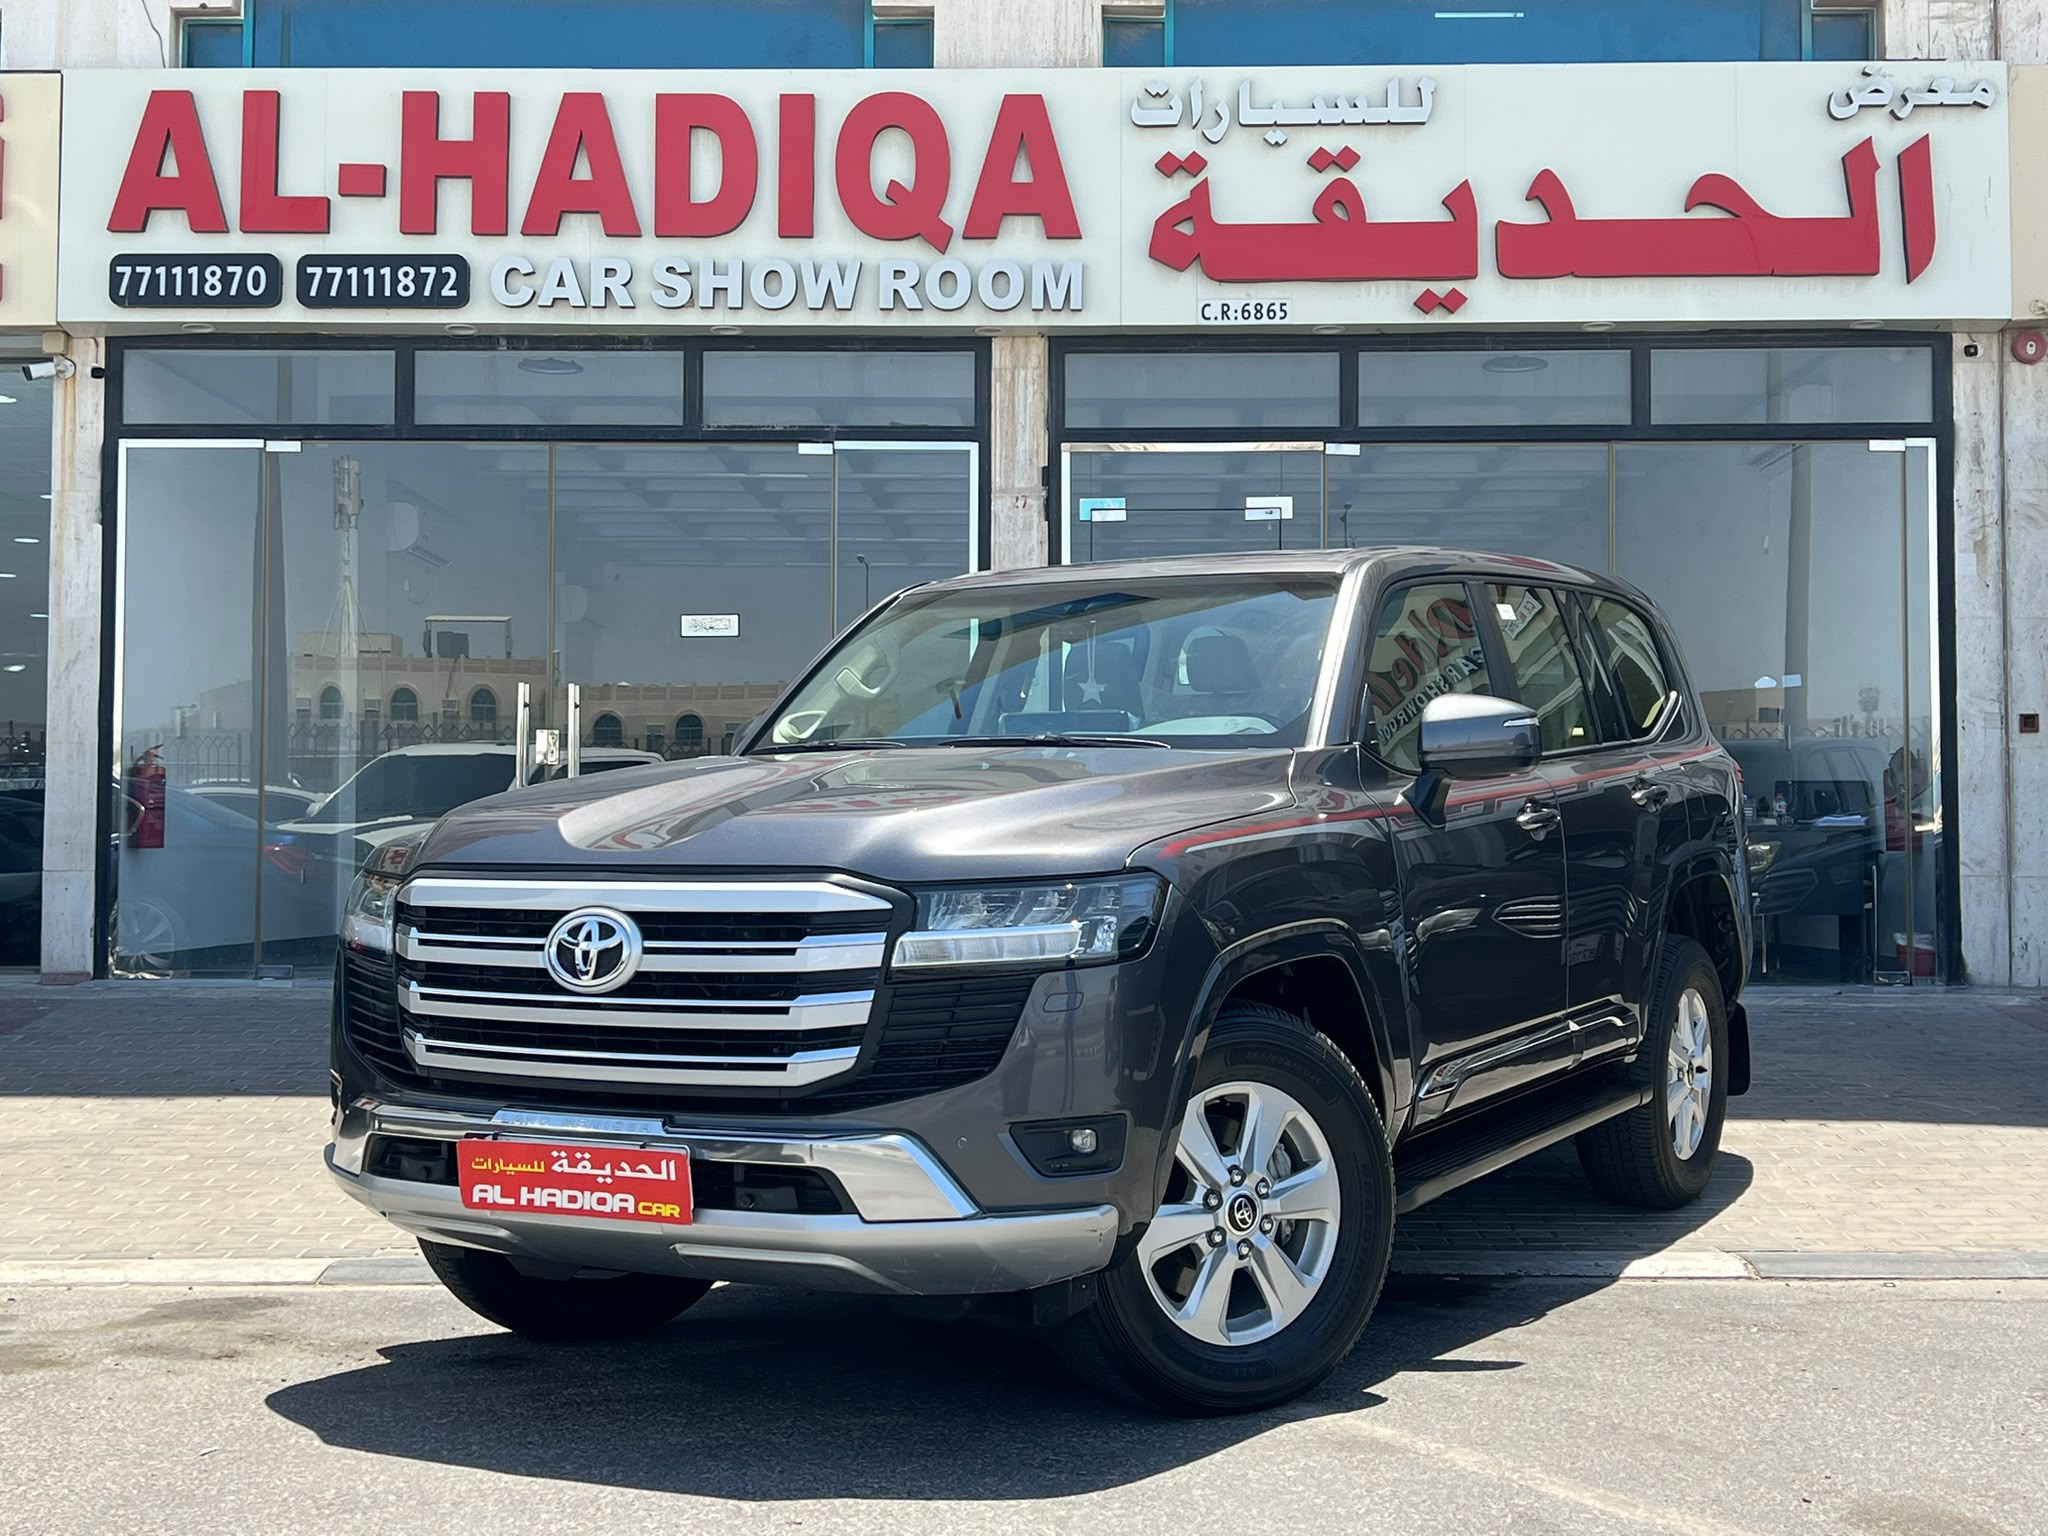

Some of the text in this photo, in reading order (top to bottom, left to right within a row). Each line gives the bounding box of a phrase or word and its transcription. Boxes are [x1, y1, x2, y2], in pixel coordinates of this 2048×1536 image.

[1131, 77, 1437, 146] للسيارات
[1827, 66, 1996, 121] معرض
[107, 90, 1082, 254] AL-HADIQA
[1149, 135, 1936, 314] الحديقة
[115, 265, 268, 297] 77111870
[305, 265, 458, 298] 77111872
[490, 257, 1086, 312] CAR SHOW ROOM
[1200, 301, 1289, 322] C.R:6865
[471, 1149, 677, 1185] الحديقة للسيارات
[472, 1184, 681, 1218] AL HADIQA CAR
